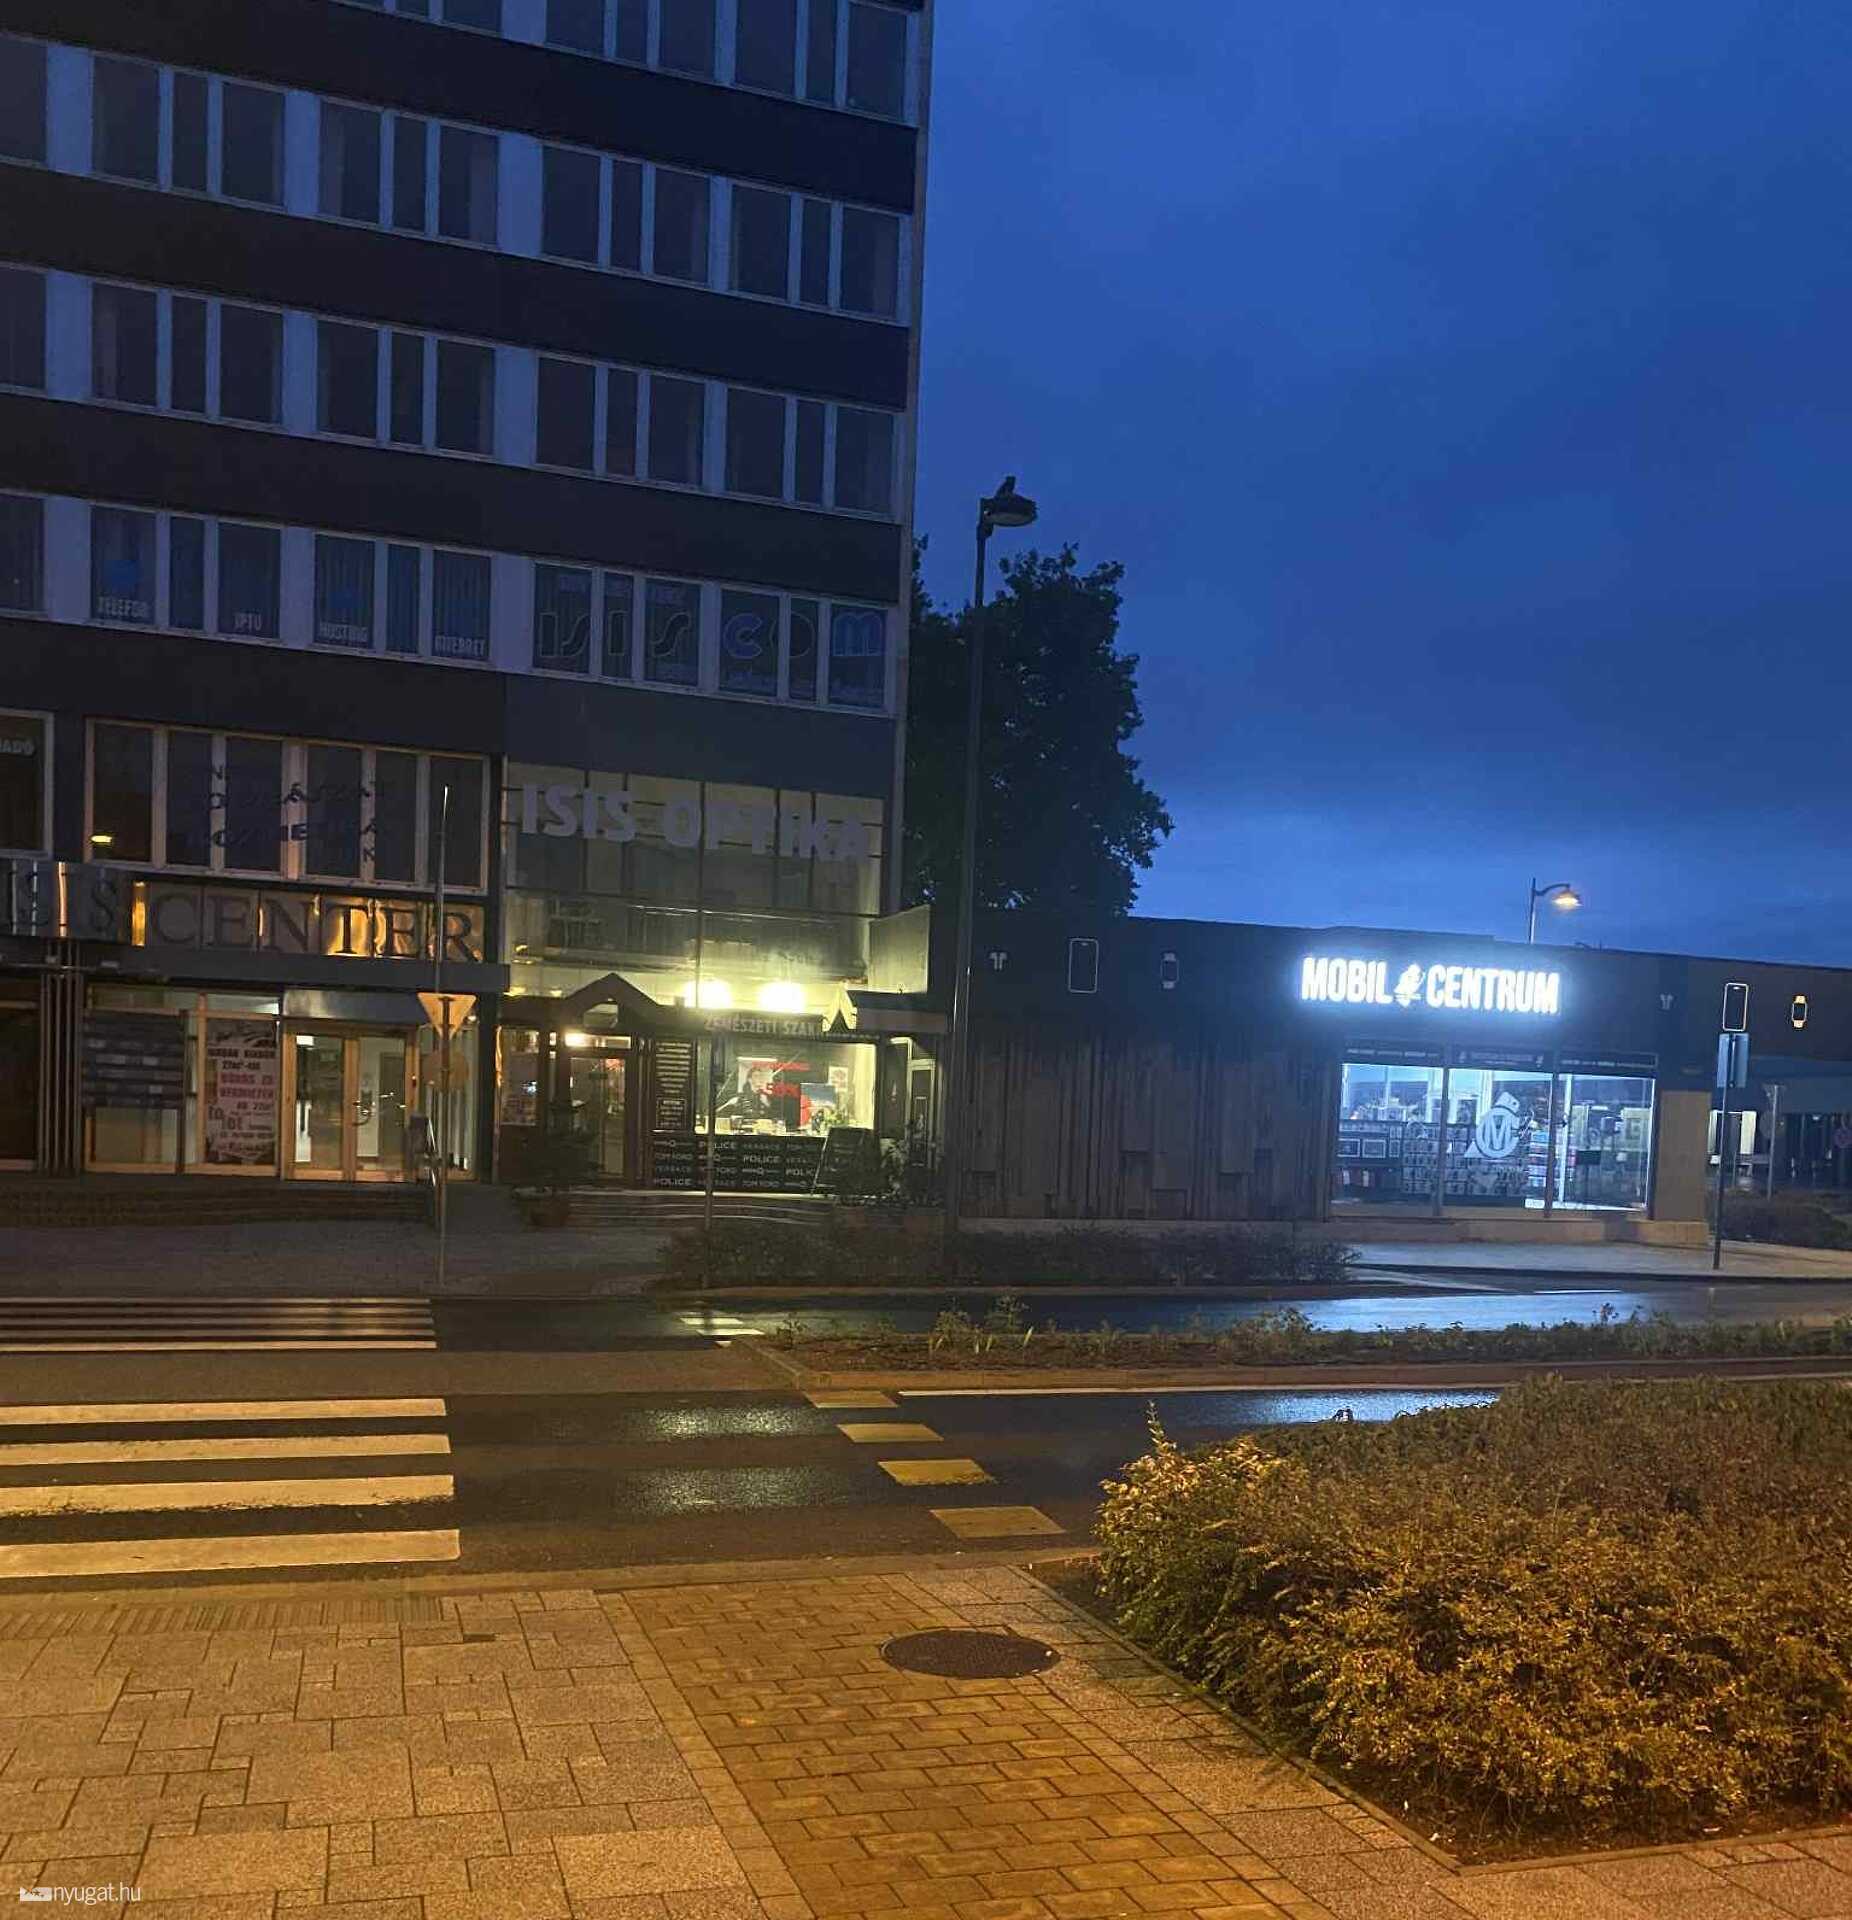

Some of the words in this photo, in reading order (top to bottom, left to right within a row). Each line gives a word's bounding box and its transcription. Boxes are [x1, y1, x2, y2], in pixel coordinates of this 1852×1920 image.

[521, 783, 638, 844] ISIS
[663, 798, 870, 863] OPTIKA
[153, 893, 485, 963] CENTER
[1301, 956, 1394, 1006] MOBIL
[1426, 963, 1560, 1015] CENTRUM
